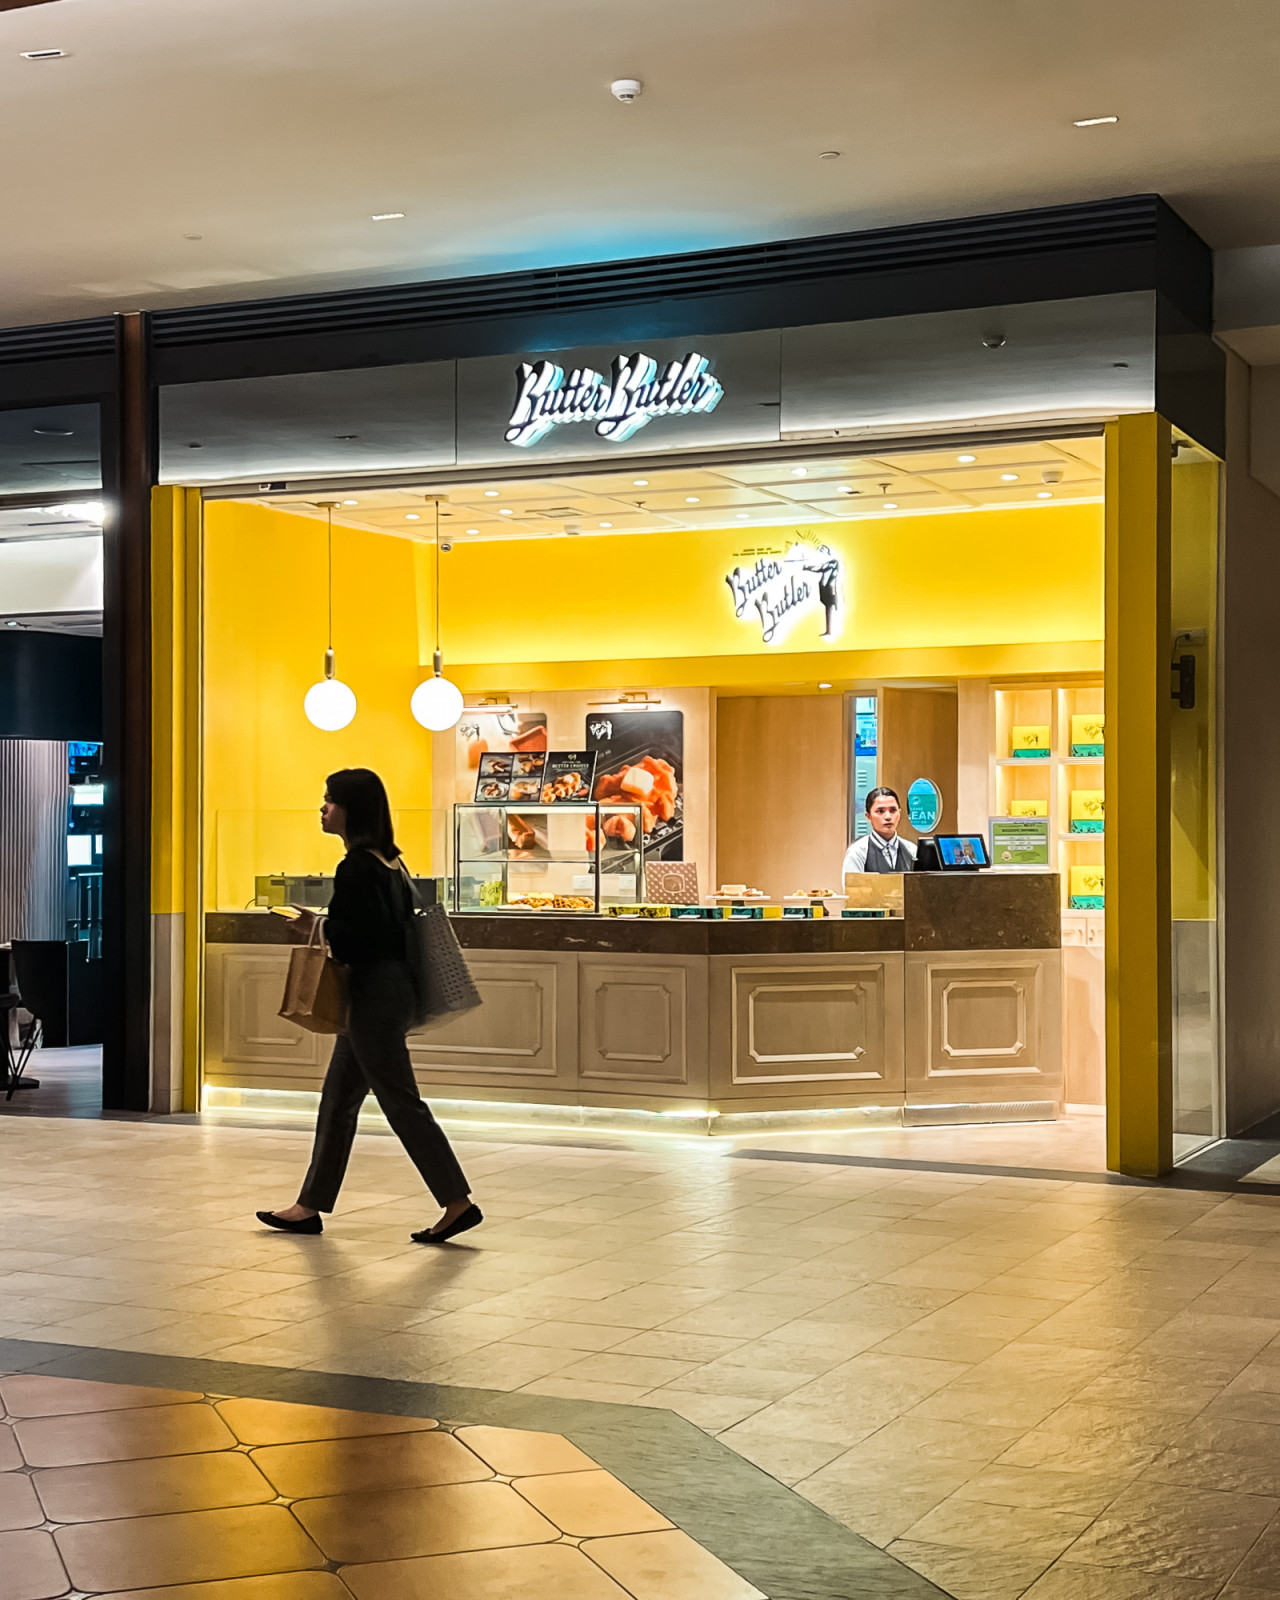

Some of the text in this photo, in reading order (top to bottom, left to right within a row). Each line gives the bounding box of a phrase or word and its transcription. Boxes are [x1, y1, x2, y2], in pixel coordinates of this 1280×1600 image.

[504, 352, 722, 446] Butter Butler
[725, 558, 782, 617] Butter
[754, 575, 810, 642] Butler
[909, 811, 936, 820] EAN
